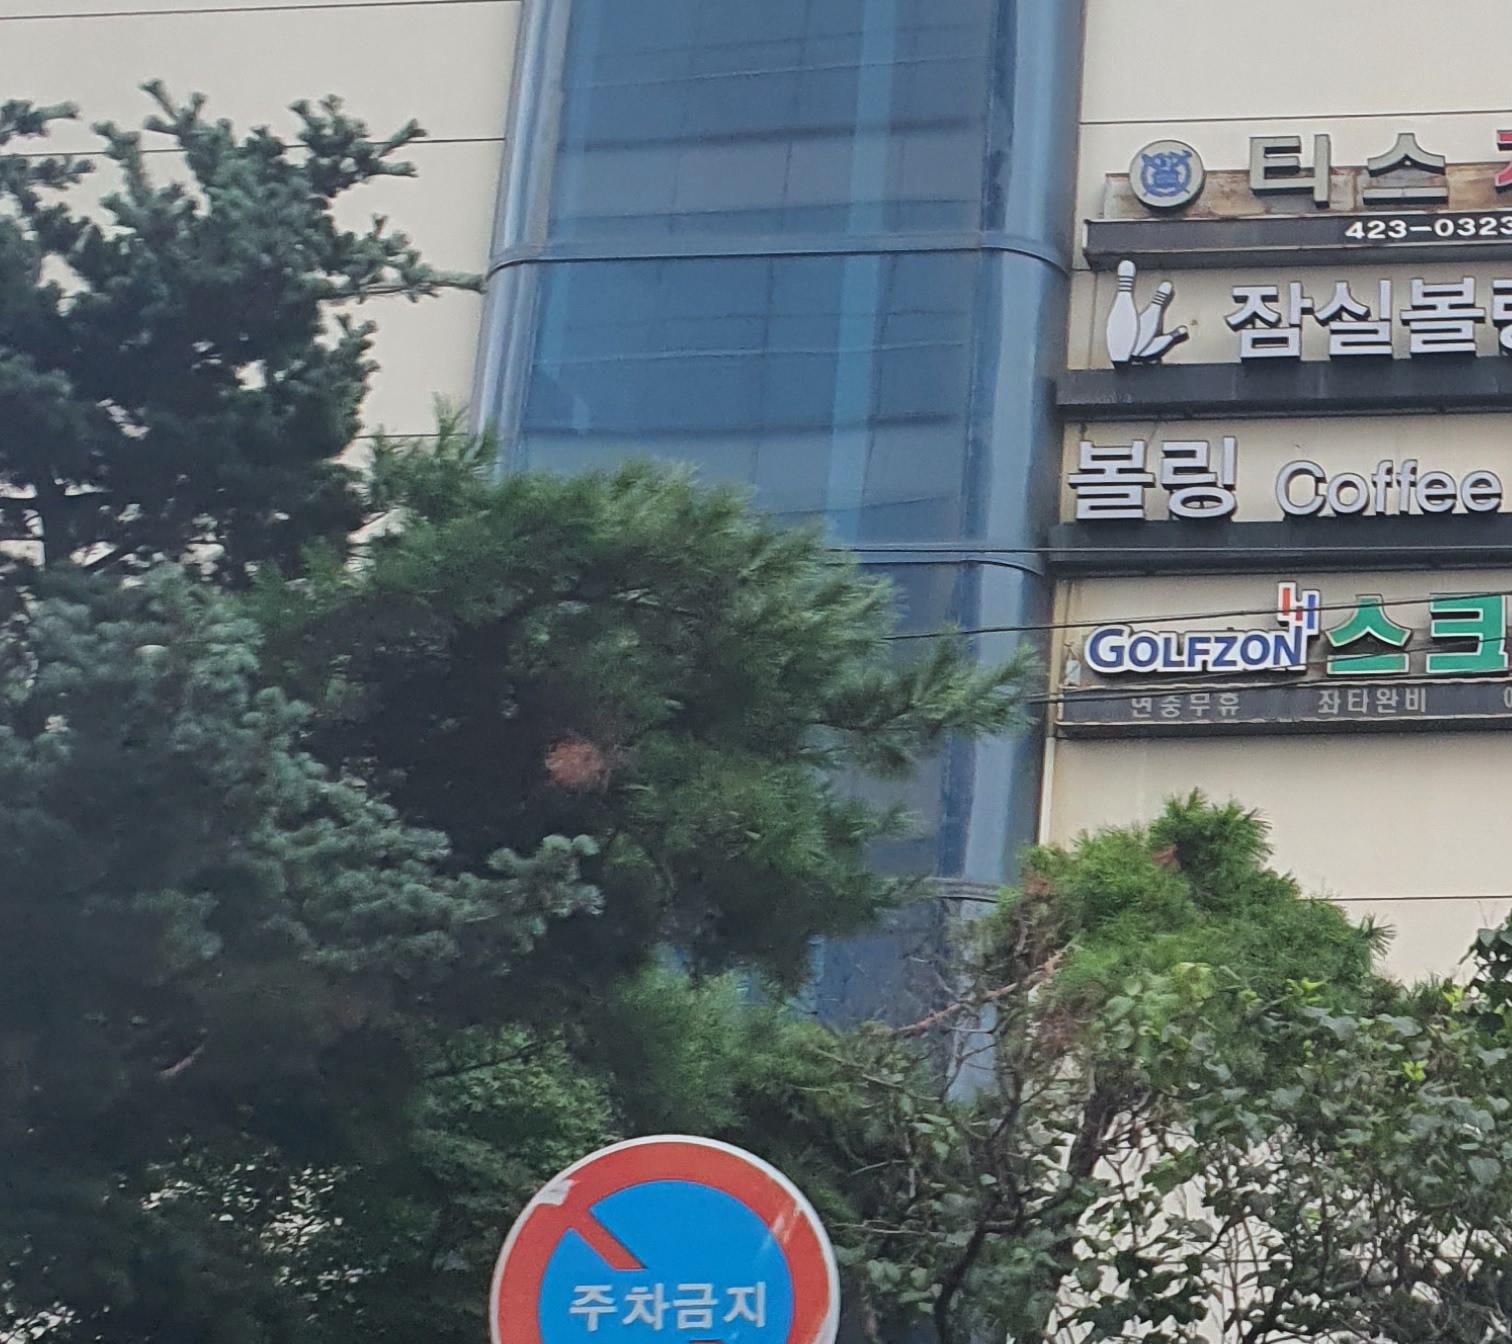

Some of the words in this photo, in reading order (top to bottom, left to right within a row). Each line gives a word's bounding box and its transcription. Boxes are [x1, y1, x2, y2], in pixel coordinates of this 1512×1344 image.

[1068, 436, 1238, 522] 볼링
[1275, 458, 1503, 517] Coffee
[1086, 626, 1308, 674] GOLFZON
[1130, 692, 1242, 718] 연중무휴
[1317, 687, 1427, 715] 좌타완비
[568, 1281, 767, 1332] 주차금지
